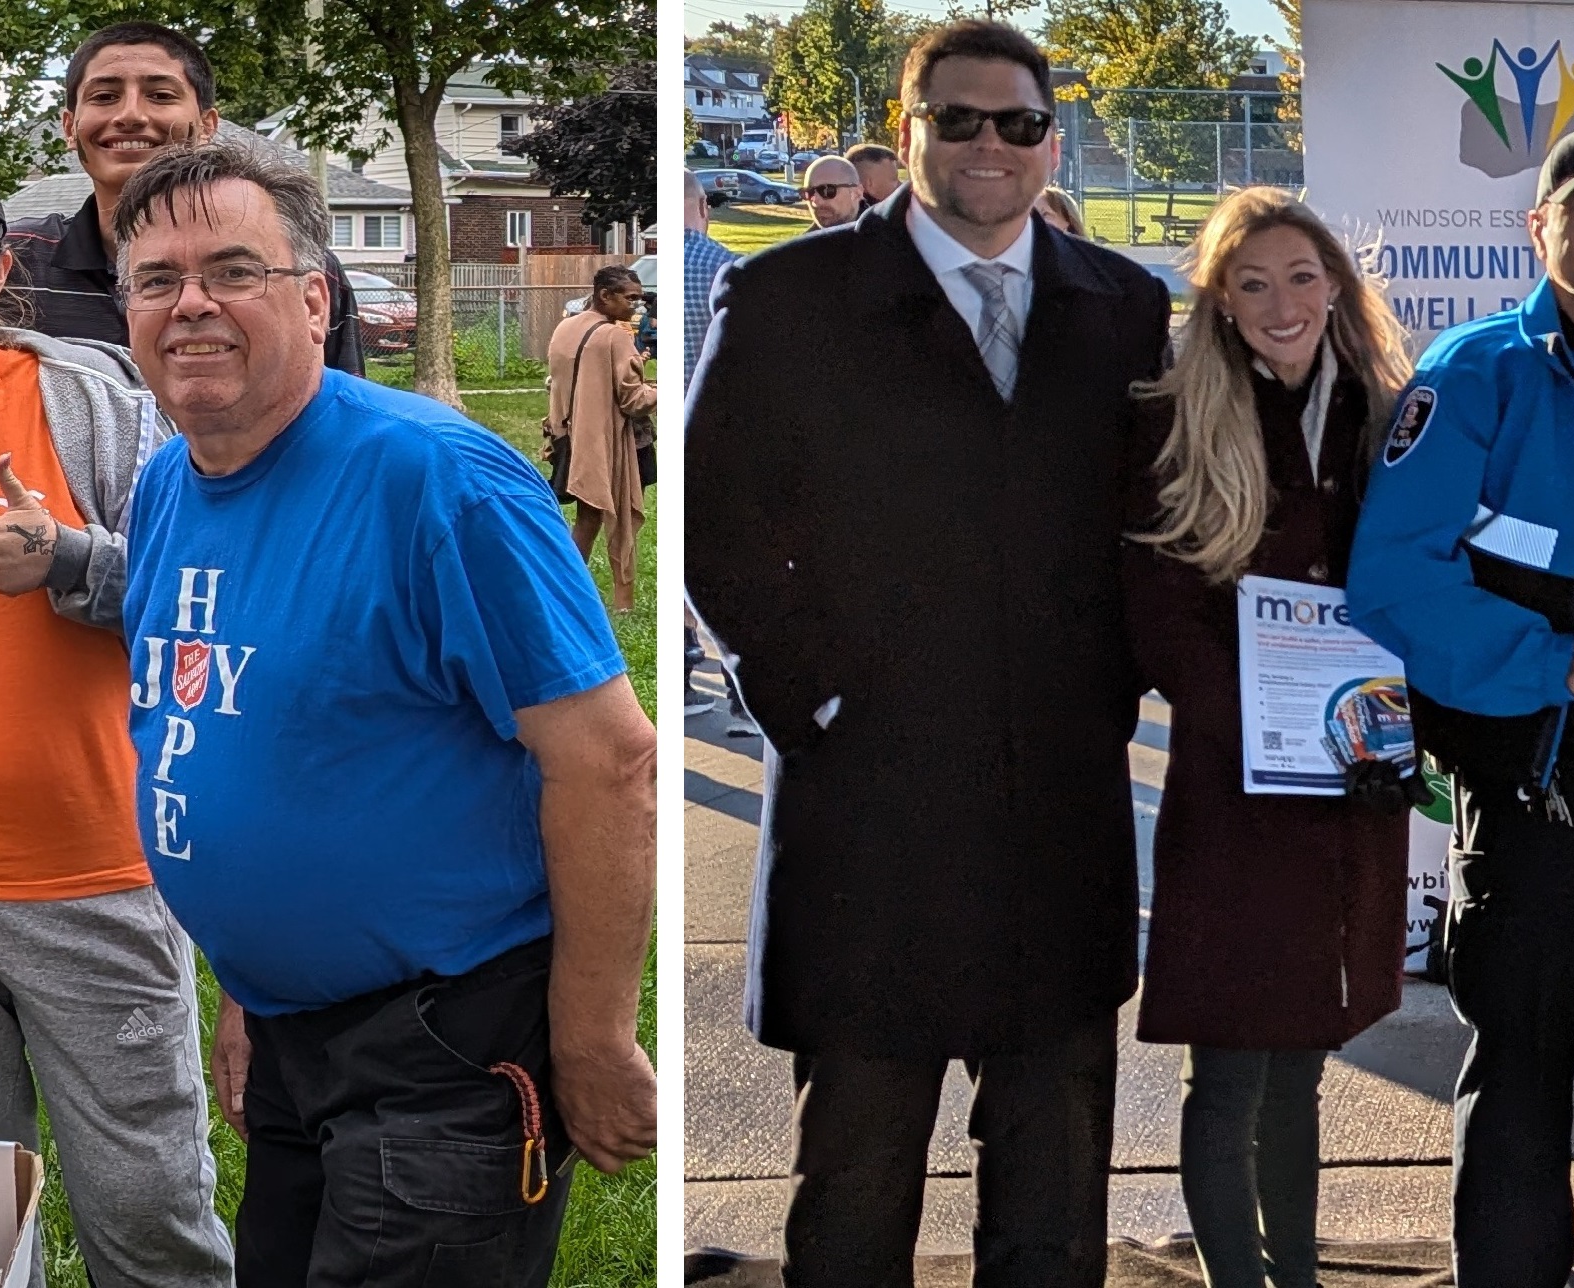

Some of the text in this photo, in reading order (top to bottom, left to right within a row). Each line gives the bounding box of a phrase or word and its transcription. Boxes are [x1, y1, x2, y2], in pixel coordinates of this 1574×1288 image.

[1377, 209, 1527, 228] WINDSOR ESS
[1376, 245, 1538, 279] OMMUNIT
[1256, 595, 1351, 626] more
[183, 648, 201, 670] THE
[117, 1024, 164, 1042] adidas
